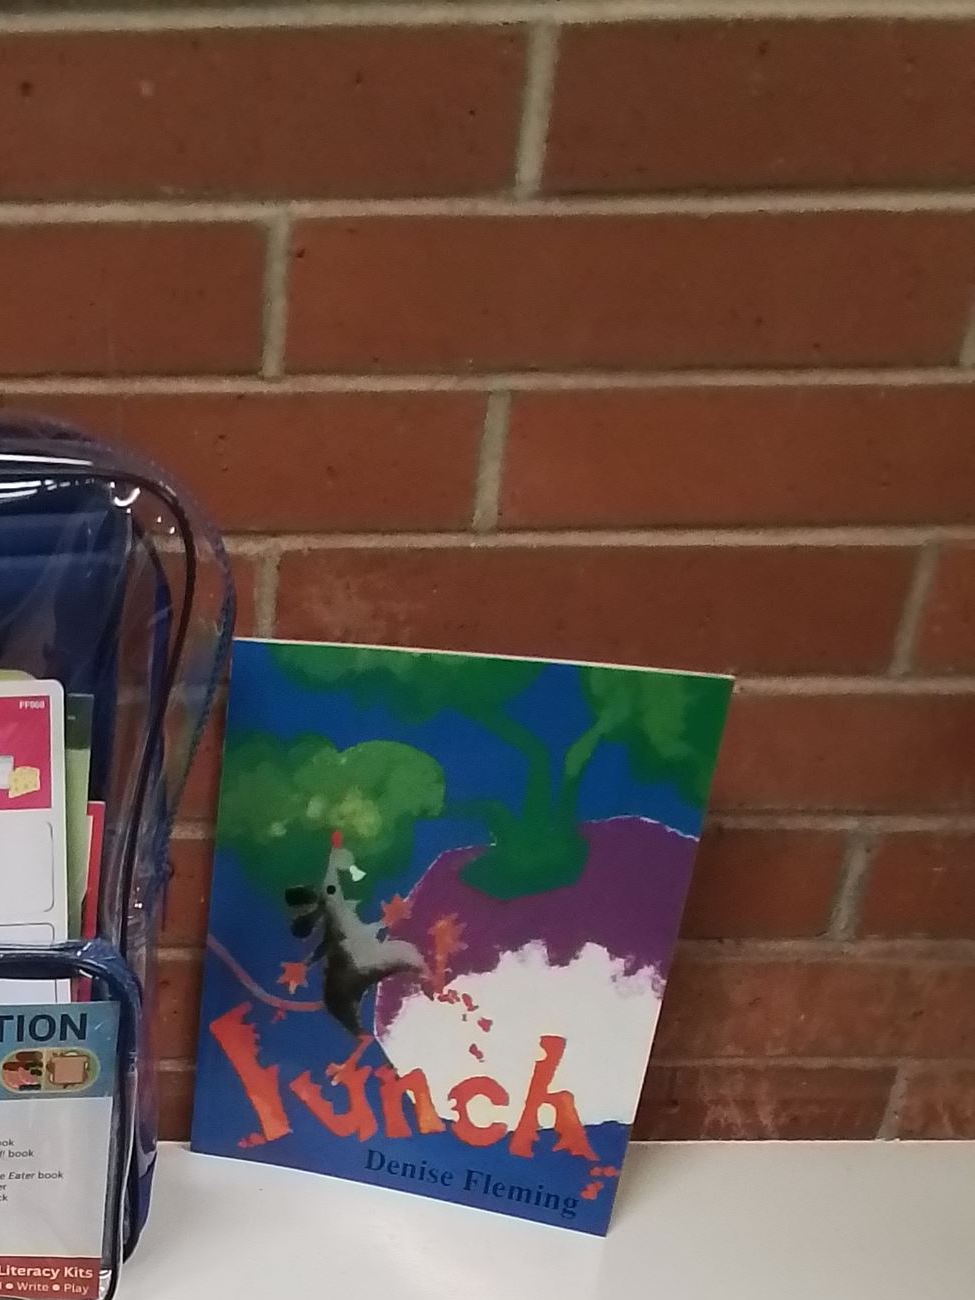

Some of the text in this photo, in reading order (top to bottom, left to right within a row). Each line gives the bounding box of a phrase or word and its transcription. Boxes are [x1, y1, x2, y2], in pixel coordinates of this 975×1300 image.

[8, 1149, 34, 1158] book
[8, 1171, 35, 1180] Eater
[38, 1170, 64, 1180] book
[365, 1149, 580, 1219] Denise Fleming
[64, 1266, 94, 1278] Kits
[17, 1282, 49, 1292] Write
[64, 1284, 90, 1295] Play
